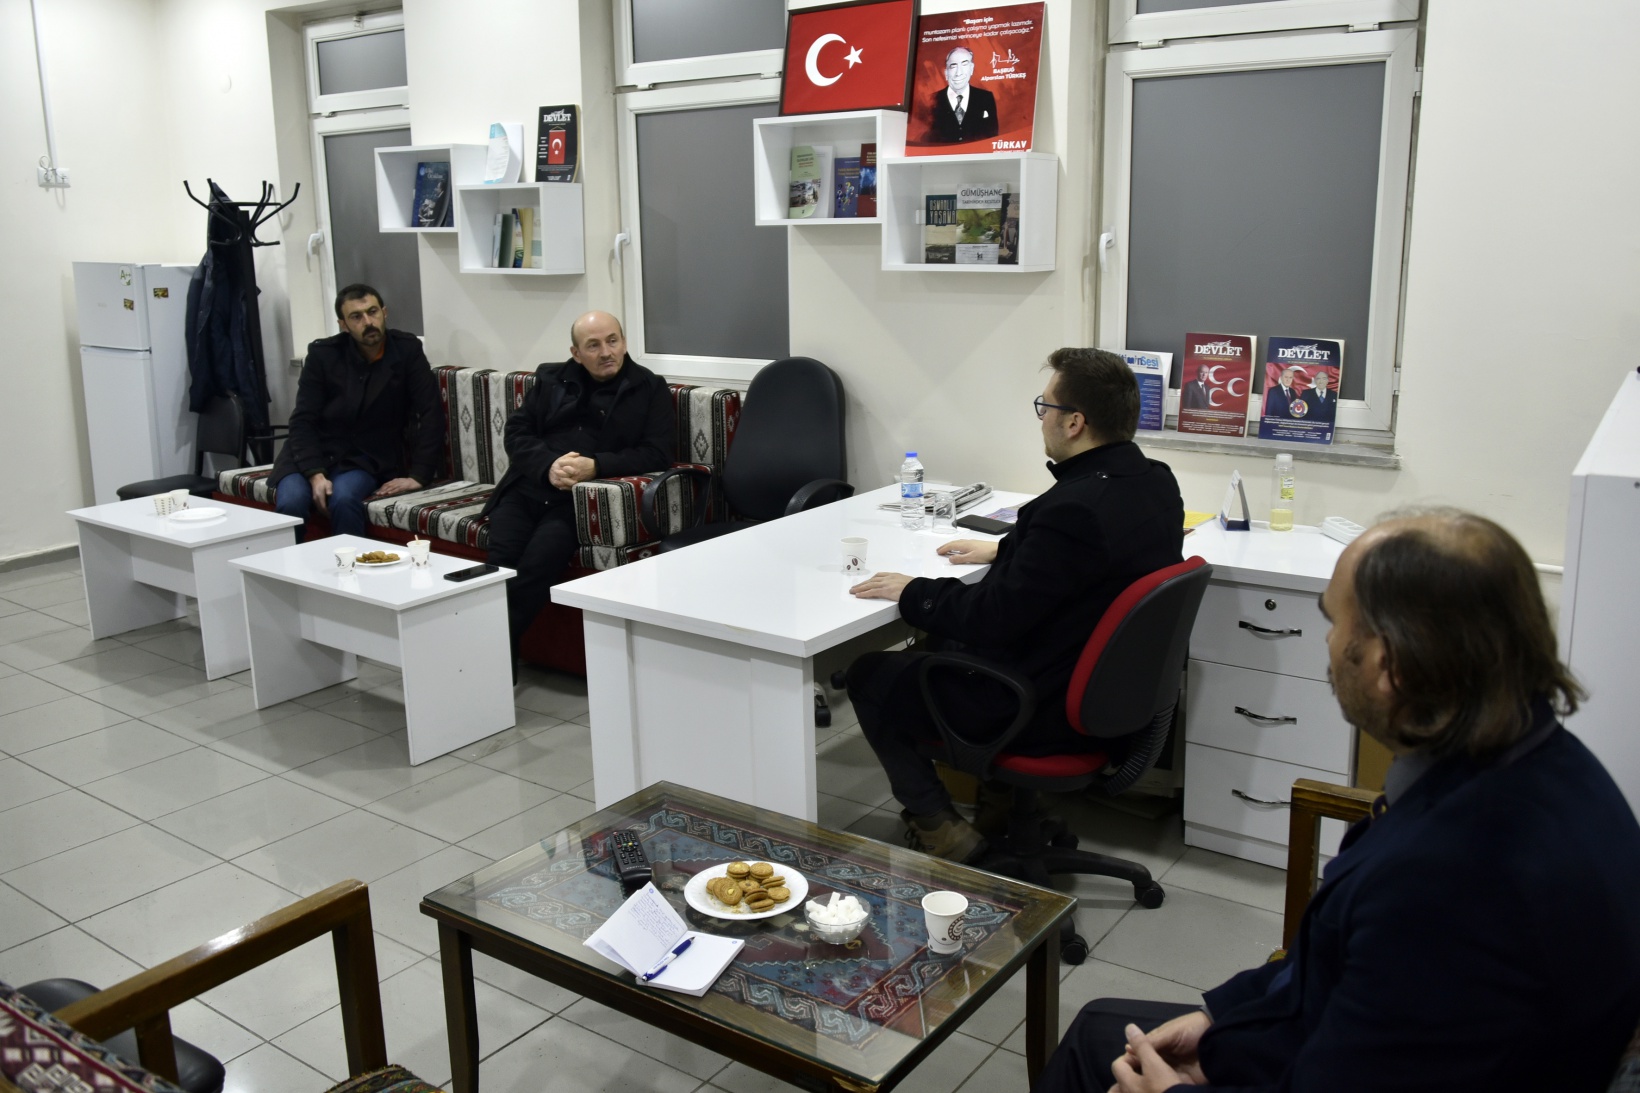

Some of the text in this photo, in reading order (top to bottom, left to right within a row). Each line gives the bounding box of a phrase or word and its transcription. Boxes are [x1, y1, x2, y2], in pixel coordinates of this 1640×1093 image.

[988, 22, 1010, 30] yapmak
[993, 66, 1015, 74] BAŞBUĞ
[1005, 72, 1026, 80] TÜRKEŞ
[543, 113, 571, 122] DEVLET
[991, 140, 1027, 150] TÜRKAV
[961, 188, 1003, 198] GÜMÜŞHANE
[1194, 344, 1243, 356] DEVLET
[1278, 348, 1331, 360] DEVLET
